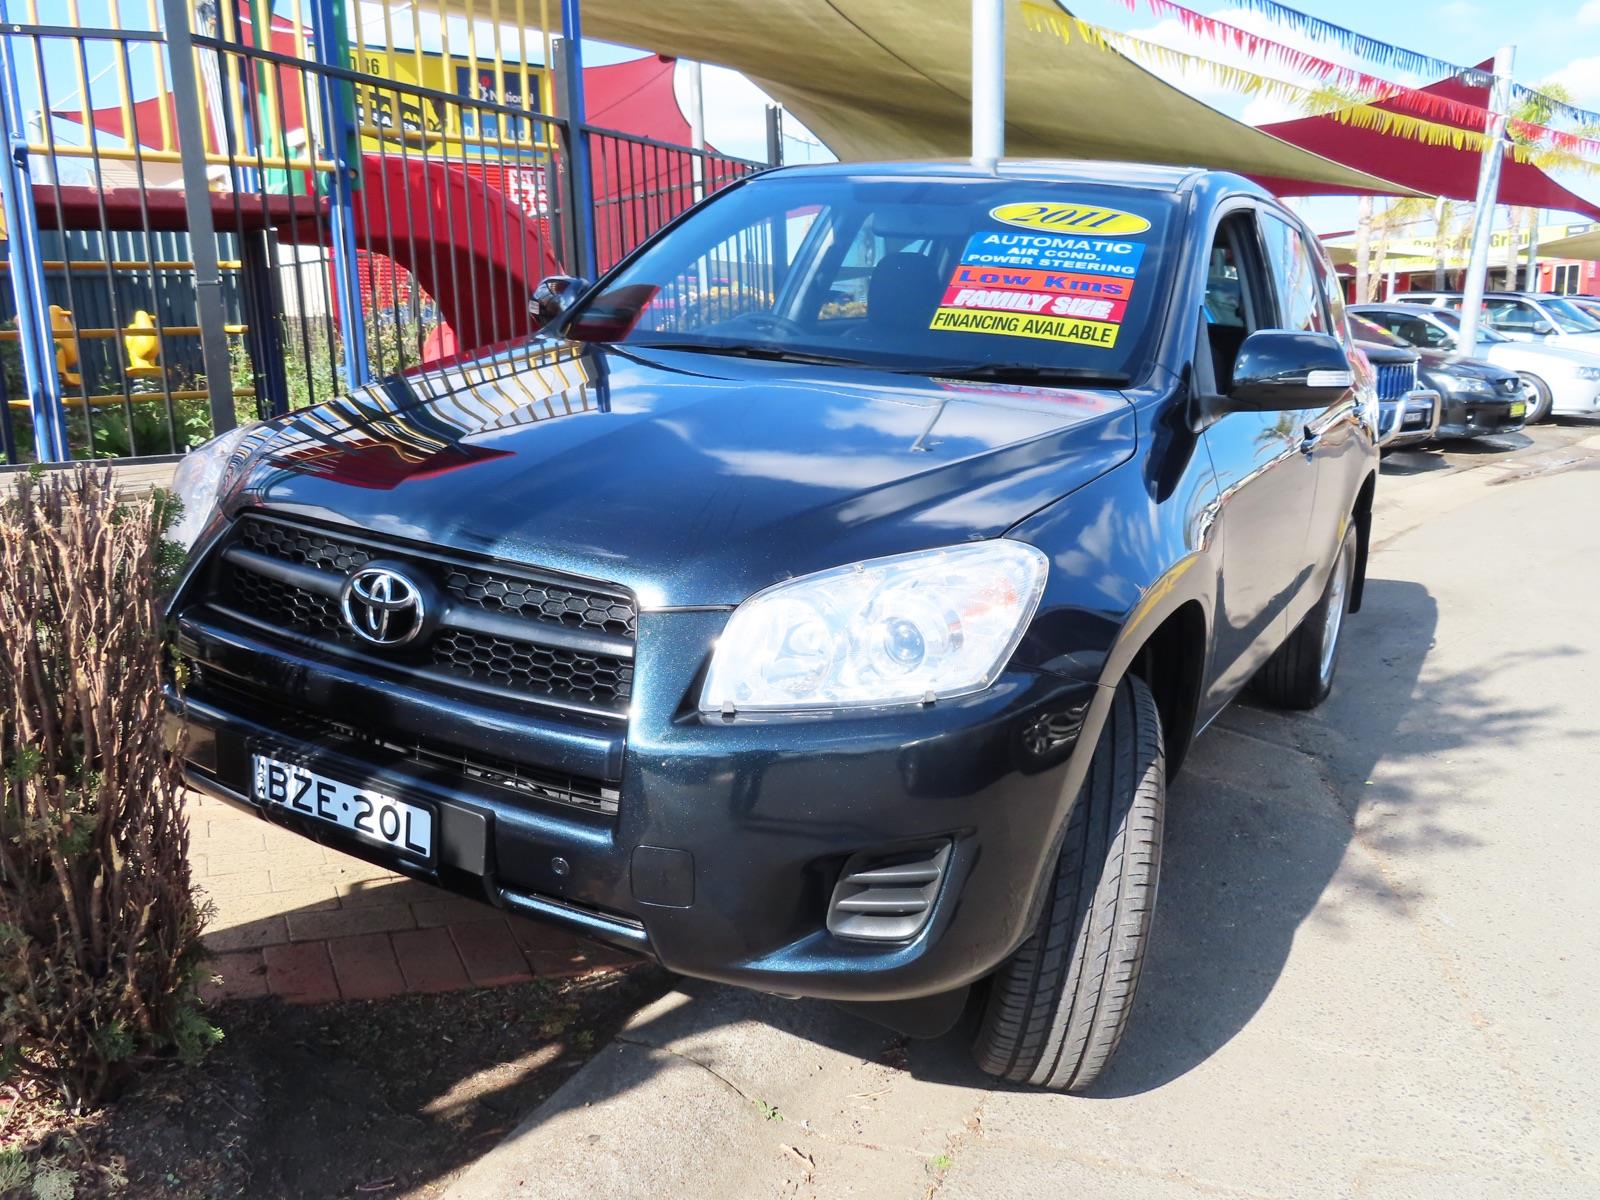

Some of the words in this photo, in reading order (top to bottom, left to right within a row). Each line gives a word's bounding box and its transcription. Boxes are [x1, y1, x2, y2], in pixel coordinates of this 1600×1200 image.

[489, 89, 535, 105] Ntionl
[1010, 206, 1121, 228] 2011
[984, 234, 1133, 254] AUTOMATIC
[1008, 247, 1040, 256] AIR
[1044, 249, 1101, 261] COND.
[968, 254, 1033, 265] POWER
[1039, 258, 1135, 275] STEERING
[1043, 275, 1123, 295] Kms
[953, 289, 1053, 313] FAMILY
[1051, 296, 1114, 320] SIZE
[934, 312, 1018, 332] FINANCING
[1022, 319, 1113, 343] AVAILABLE
